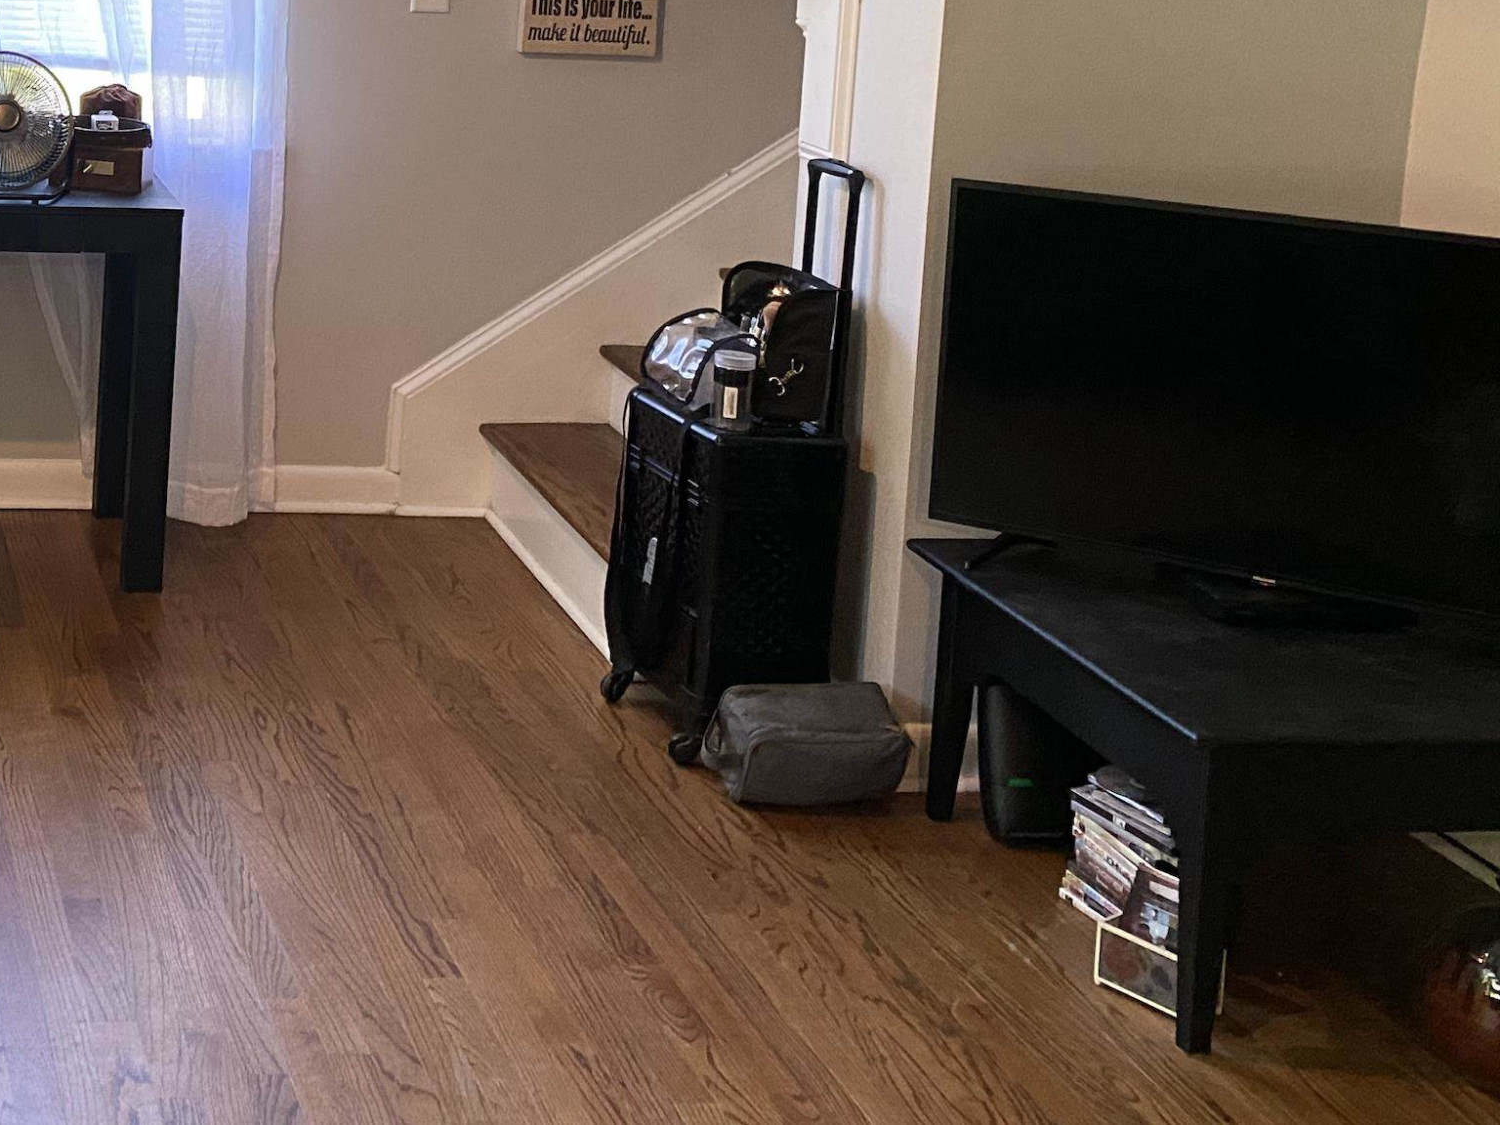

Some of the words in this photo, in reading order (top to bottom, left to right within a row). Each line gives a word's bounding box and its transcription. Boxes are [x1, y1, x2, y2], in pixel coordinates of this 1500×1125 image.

[528, 23, 567, 41] make
[570, 23, 581, 42] it
[584, 23, 650, 50] beautiful.
